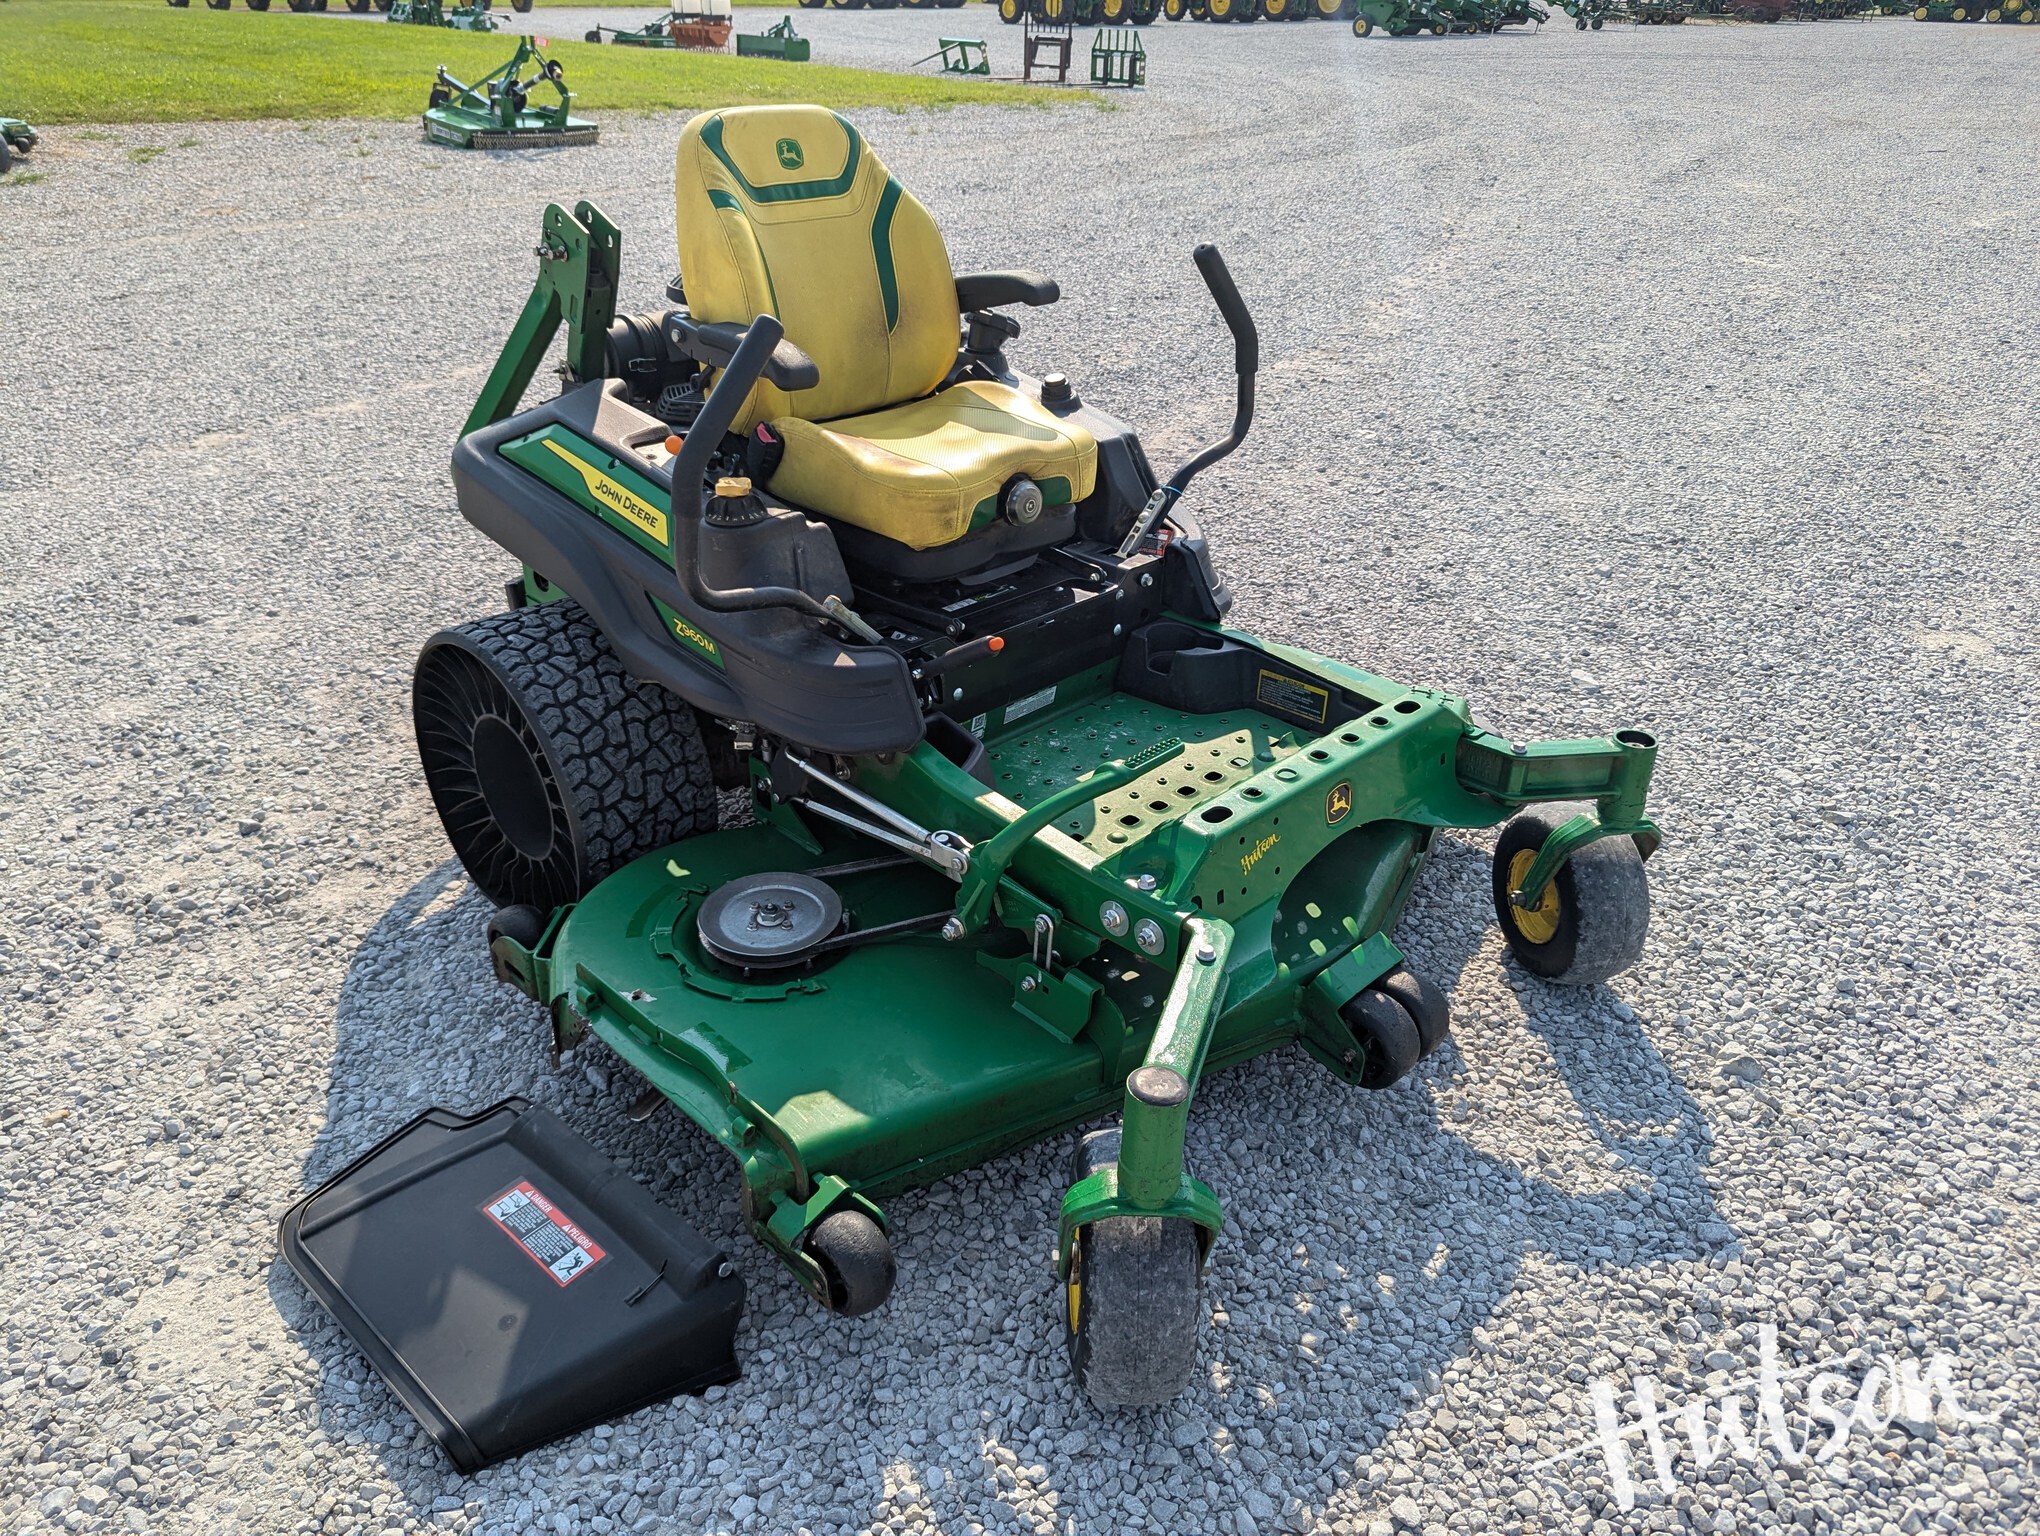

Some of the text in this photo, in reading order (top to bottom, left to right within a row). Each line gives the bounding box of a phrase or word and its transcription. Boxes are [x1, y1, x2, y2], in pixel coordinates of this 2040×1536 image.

[595, 480, 658, 528] JOHN DEERE
[673, 617, 715, 654] Z960M
[1240, 832, 1281, 875] Hutson
[530, 1194, 553, 1213] DANGER
[568, 1224, 593, 1249] PELIGRO
